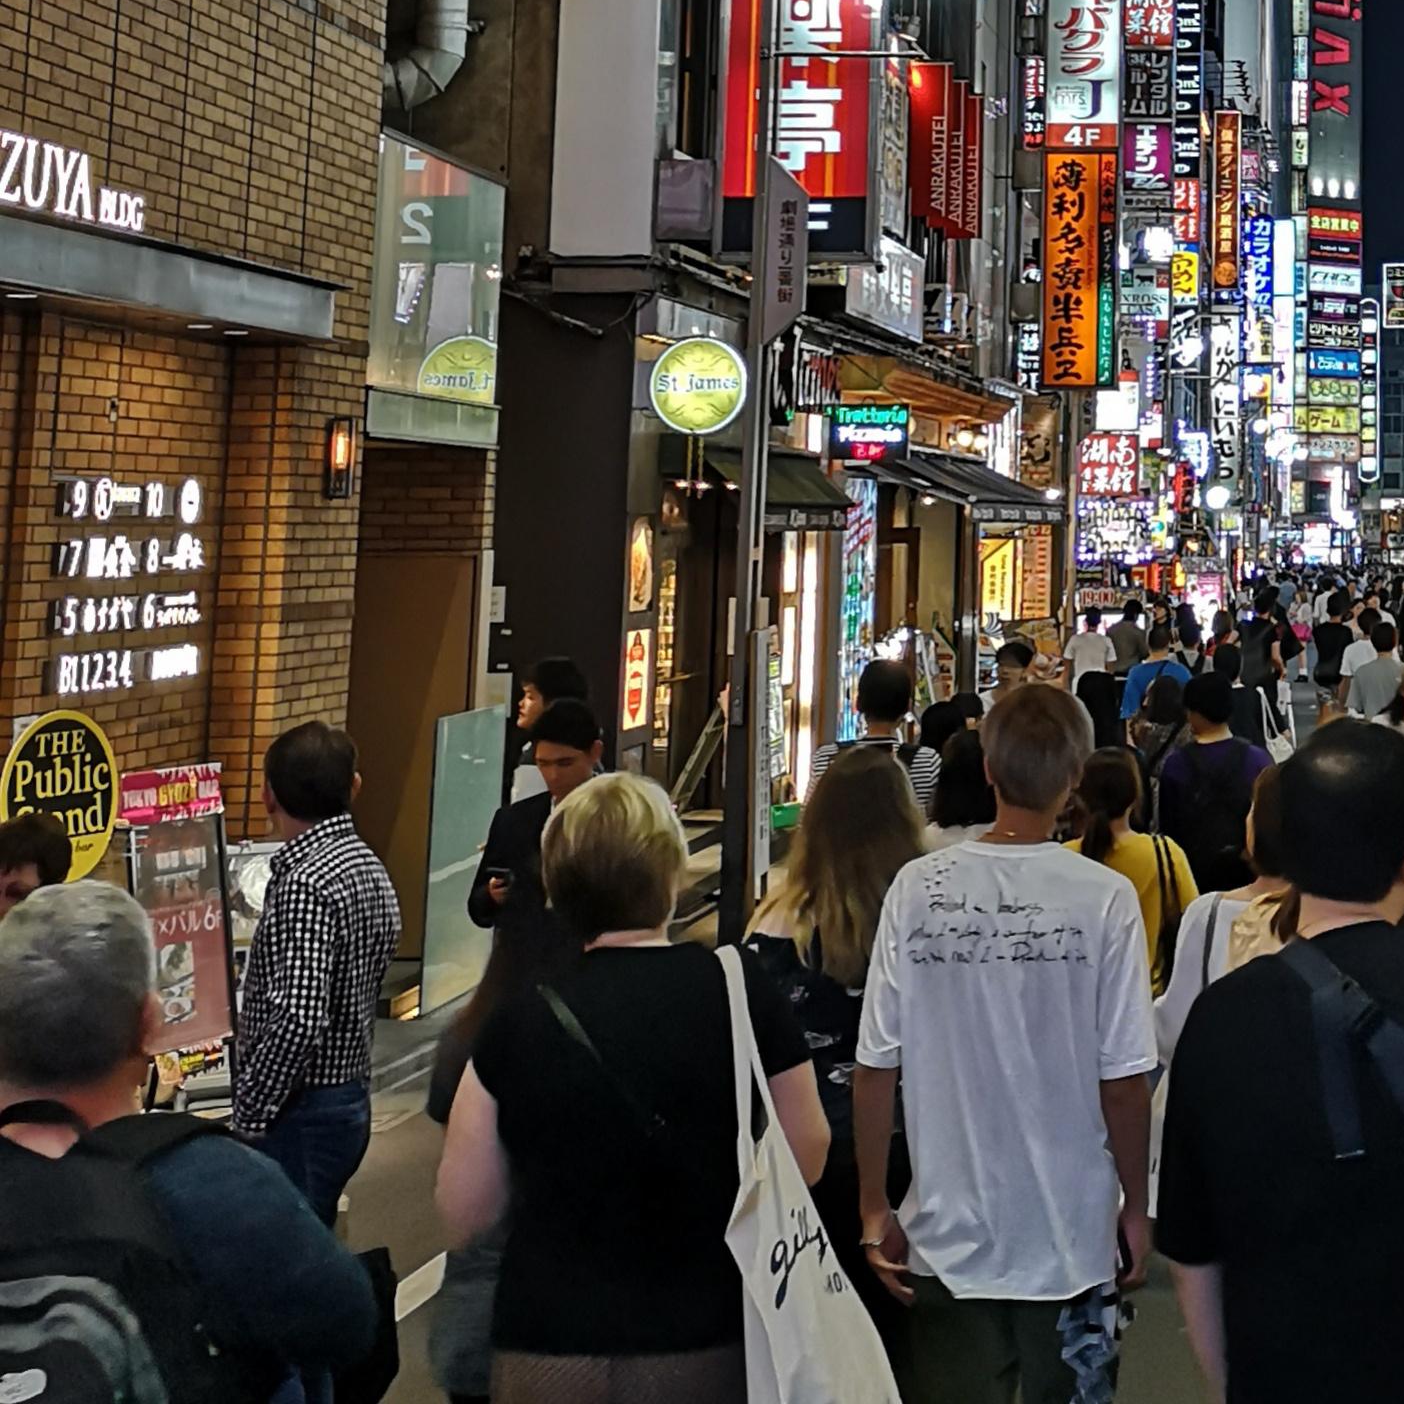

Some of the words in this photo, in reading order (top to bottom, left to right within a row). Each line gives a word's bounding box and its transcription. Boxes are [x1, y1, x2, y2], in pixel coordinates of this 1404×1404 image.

[1063, 126, 1101, 146] 4F
[930, 115, 946, 217] ANRAKUTEI
[947, 130, 963, 229] ANRAKUTEI
[777, 200, 798, 304] 劇場通り一番街
[35, 728, 86, 758] THE
[13, 752, 110, 803] Public
[159, 780, 197, 807] GYOZA
